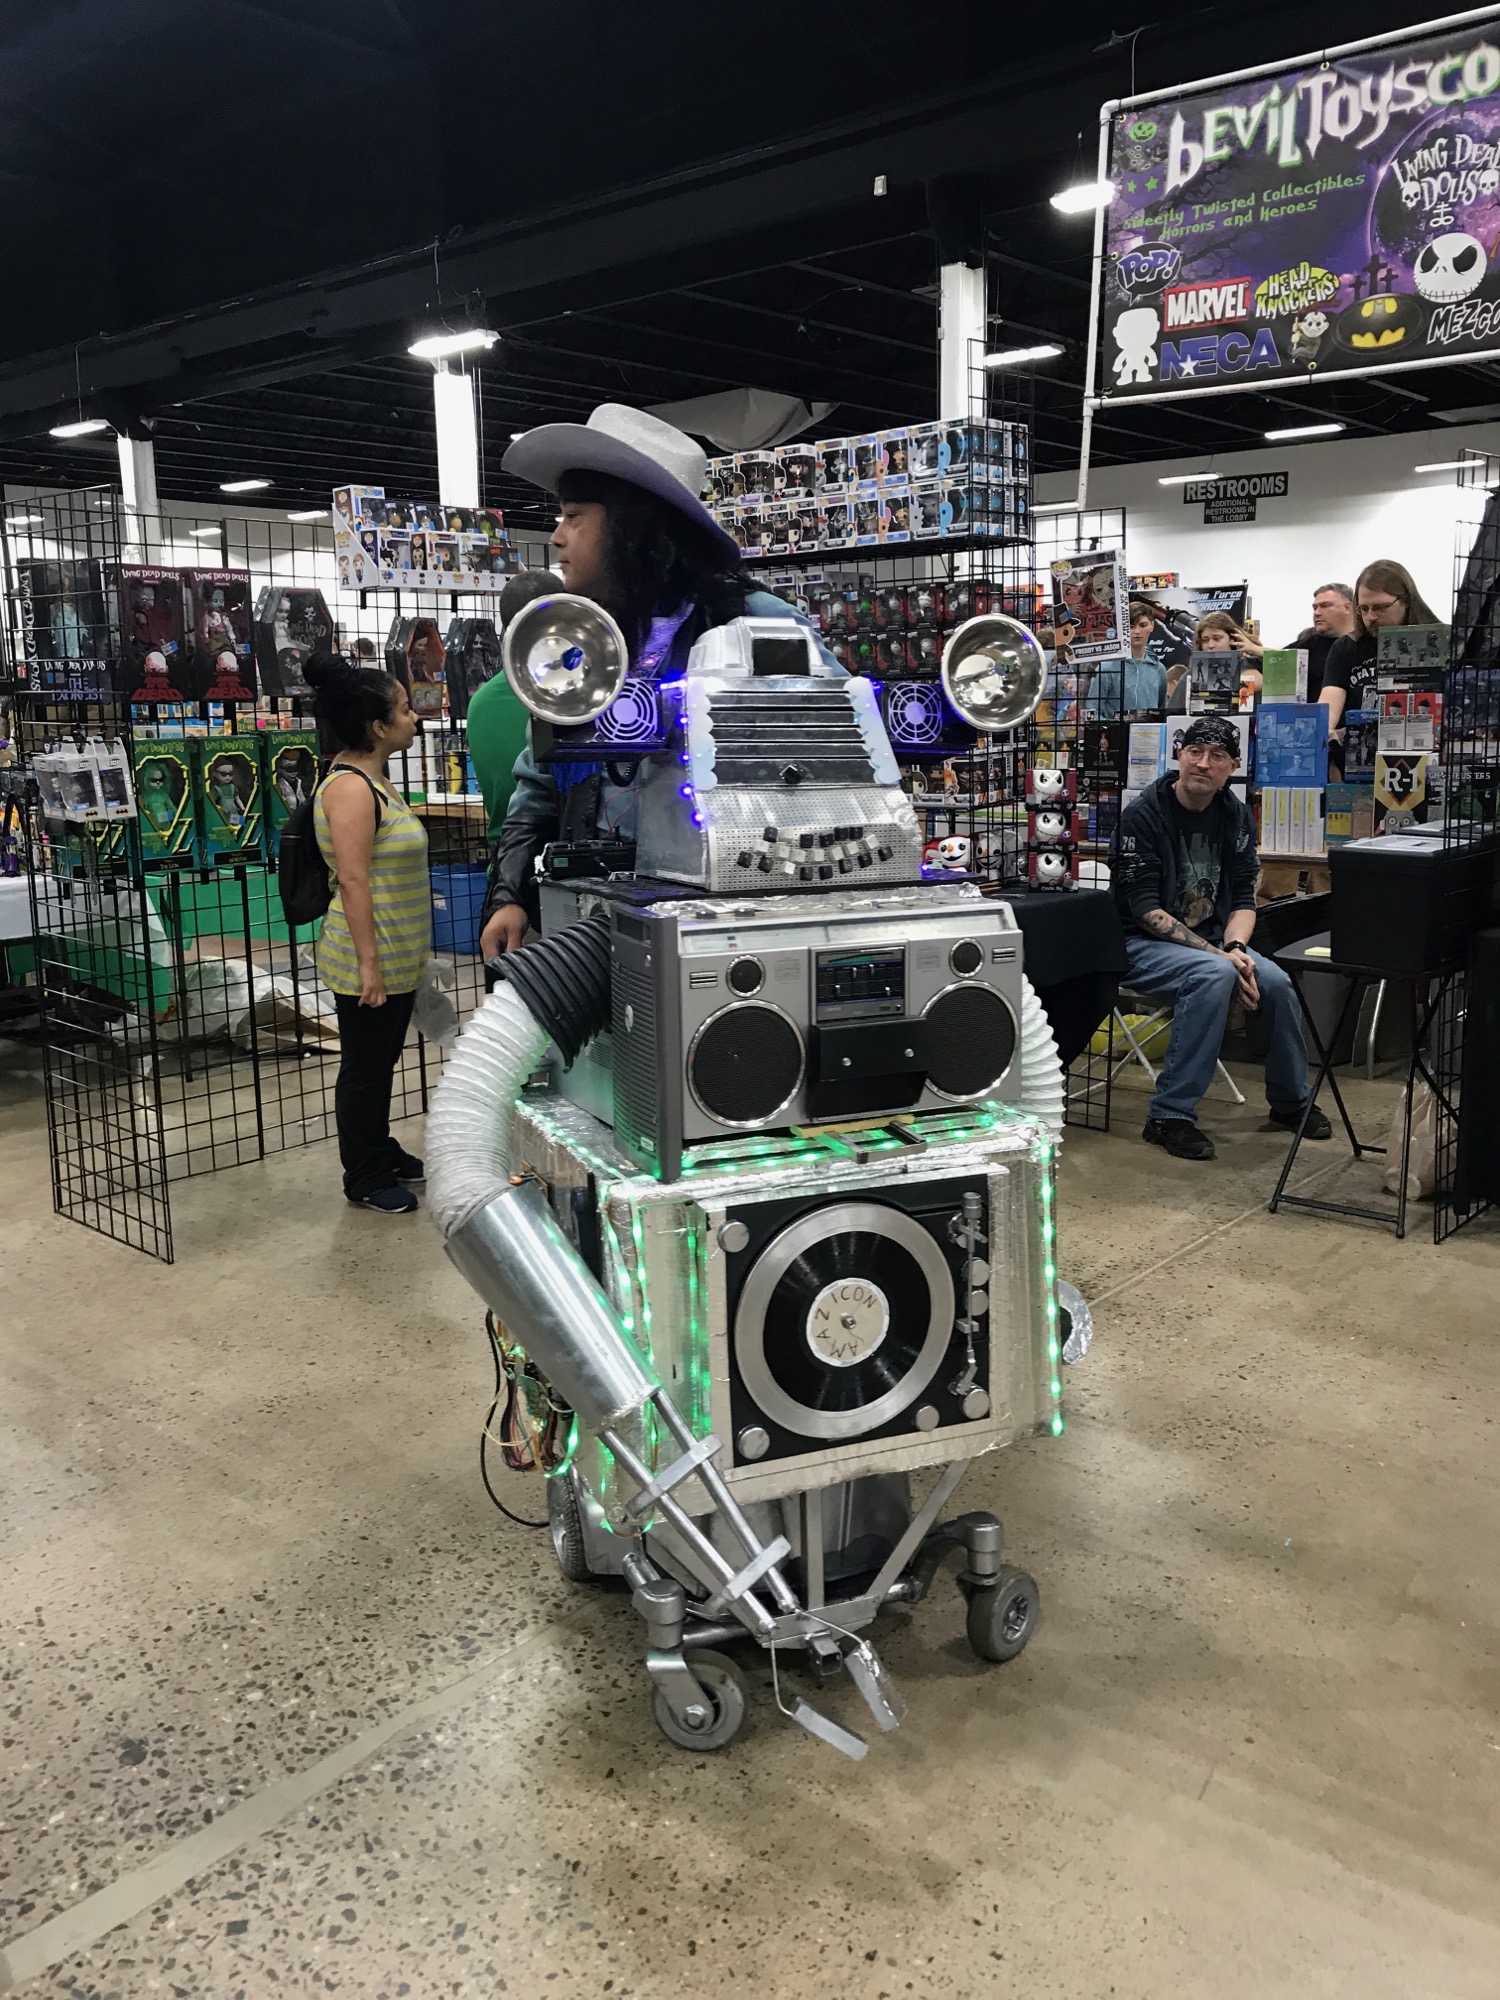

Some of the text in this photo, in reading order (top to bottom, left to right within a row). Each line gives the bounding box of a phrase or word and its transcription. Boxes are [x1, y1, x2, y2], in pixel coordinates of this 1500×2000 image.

[1390, 138, 1449, 189] LIVING
[1122, 173, 1366, 230] Sweetly Twisted Collectibles
[1421, 170, 1483, 211] DOLLS
[1162, 199, 1318, 241] Horrors and Heroes
[1117, 249, 1181, 289] POP!
[1268, 262, 1312, 297] HEAD
[1166, 283, 1247, 327] MARVEL
[1255, 274, 1336, 319] KNOCKERS
[1159, 327, 1282, 382] NECA
[1186, 475, 1286, 500] RESTROOMS
[1210, 499, 1251, 508] ADDITIONAL
[1205, 505, 1255, 515] RESTROOMS IN
[1225, 514, 1249, 522] LOBBY
[142, 569, 160, 578] DEAD
[161, 570, 180, 580] DOLLS
[213, 572, 231, 581] DEAD
[231, 573, 249, 582] DOLLS
[1383, 767, 1420, 792] R-1
